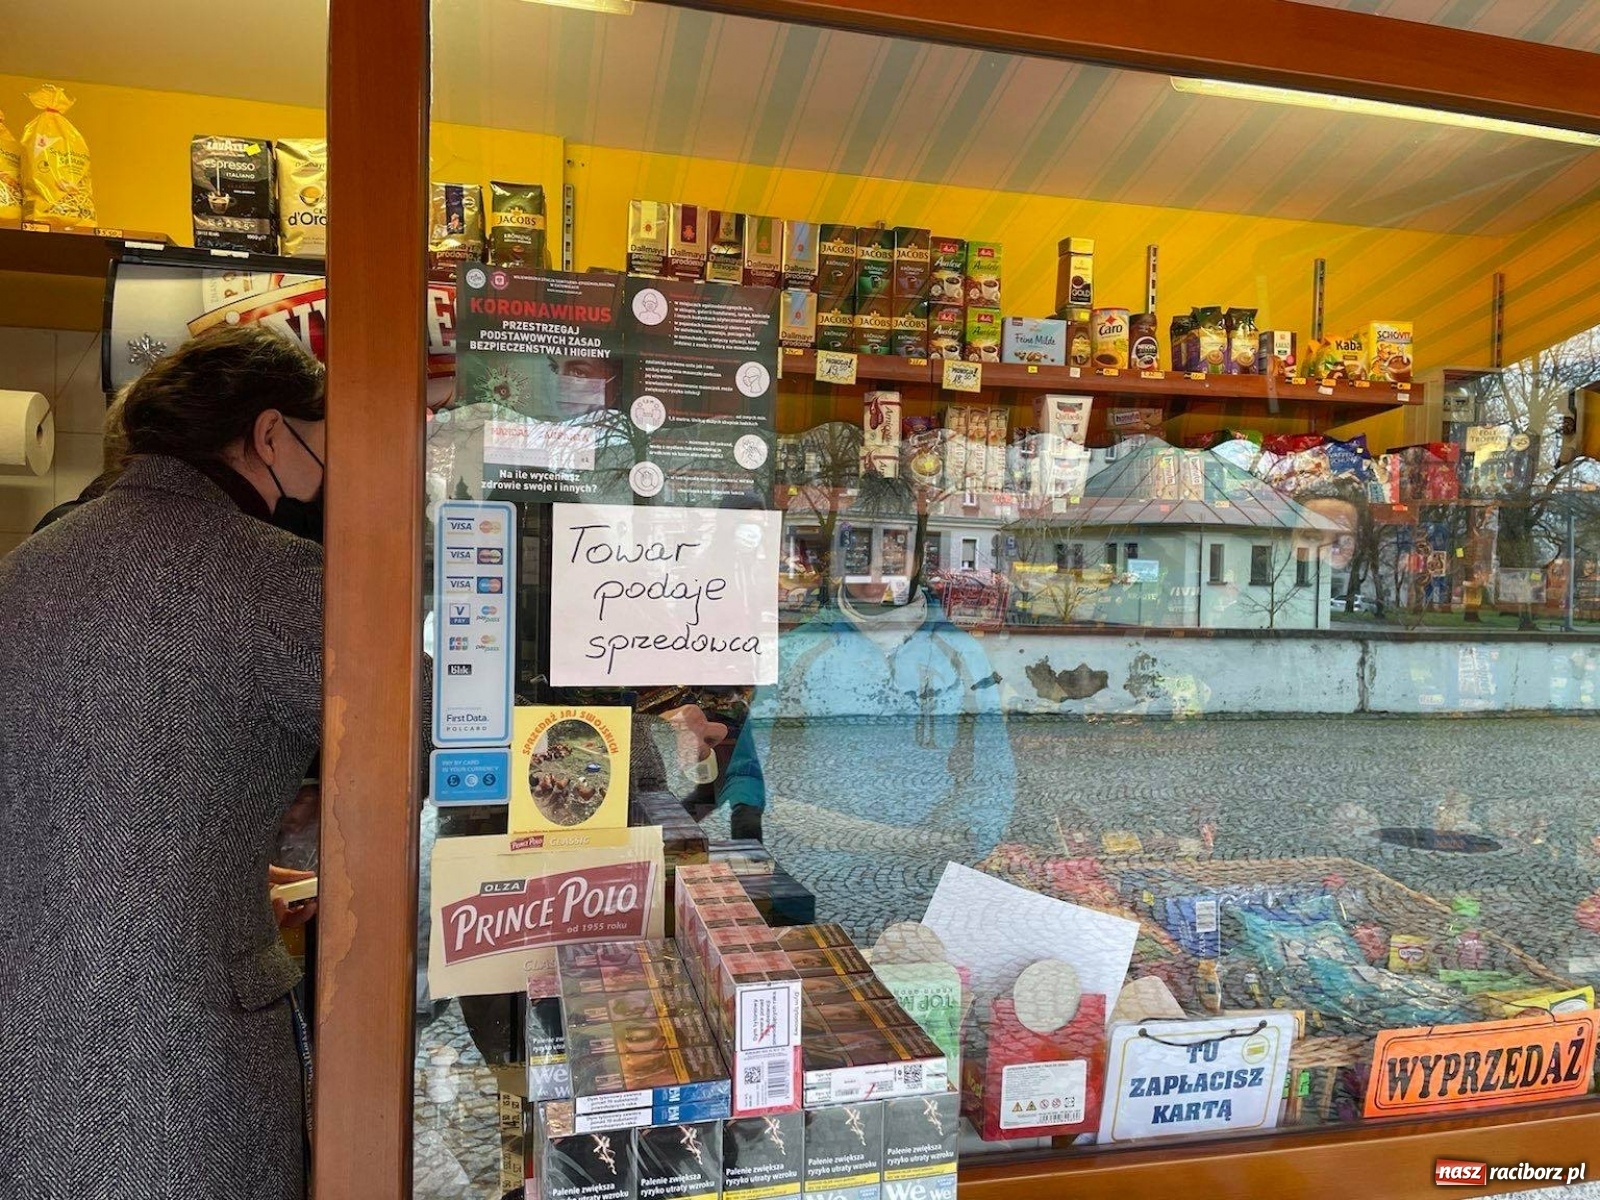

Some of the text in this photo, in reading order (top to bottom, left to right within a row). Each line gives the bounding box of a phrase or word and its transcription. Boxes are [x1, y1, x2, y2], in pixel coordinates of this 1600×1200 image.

[202, 159, 256, 172] espresso
[226, 172, 255, 180] ITALIANO
[498, 215, 537, 226] JACOBS
[822, 244, 855, 254] JACOBS
[860, 249, 892, 259] JACOBS
[897, 250, 929, 260] JACOBS
[470, 297, 612, 323] KORONAWIRUS
[820, 316, 852, 325] JACOBS
[860, 318, 892, 327] JACOBS
[893, 319, 926, 329] JACOBS
[502, 320, 580, 335] PRZESTRZEGAJ
[1098, 323, 1123, 336] Caro
[480, 330, 601, 348] PODSTAWOWYCH ZASAD
[1015, 333, 1057, 346] Feine Milde
[1377, 330, 1412, 340] SCHOVIT
[470, 340, 562, 356] BEZPIECZEŃSTWA
[570, 348, 612, 359] HIGIENY
[1335, 340, 1363, 351] Kaba
[499, 470, 580, 482] Na ile wyceniasz
[481, 480, 521, 490] zdrowie
[523, 482, 553, 492] swoje
[560, 484, 598, 494] innych?
[450, 522, 472, 531] VISA
[569, 525, 701, 564] Towar
[450, 551, 471, 559] VISA
[450, 580, 471, 589] VISA
[593, 573, 727, 626] podaje
[450, 664, 471, 675] blik
[446, 714, 465, 723] First
[560, 709, 577, 719] JAJ
[579, 710, 620, 754] SWOJSKICH
[484, 882, 522, 892] OLZA
[450, 876, 638, 952] PRINCE POLO
[566, 921, 628, 934] od 1955 roku
[1186, 1040, 1220, 1064] TU
[1387, 1026, 1585, 1102] WYPRZEDAŻ
[1129, 1067, 1266, 1098] ZAPŁACISZ
[1151, 1099, 1233, 1124] KARTĄ
[887, 1142, 942, 1156] Palenie zwiększa
[808, 1151, 865, 1166] Palenie zwiększa
[887, 1150, 955, 1165] ryzyko utraty wzroku
[725, 1162, 784, 1177] Palenie zwiększa
[808, 1159, 878, 1177] ryzyko utraty wzroku
[640, 1173, 702, 1187] Palenie zwiększa
[725, 1170, 798, 1186] ryzyko utraty wzroku
[553, 1182, 616, 1197] Palenie zwiększa
[602, 1189, 629, 1200] wzroku
[640, 1180, 715, 1196] ryzyko utraty wzroku
